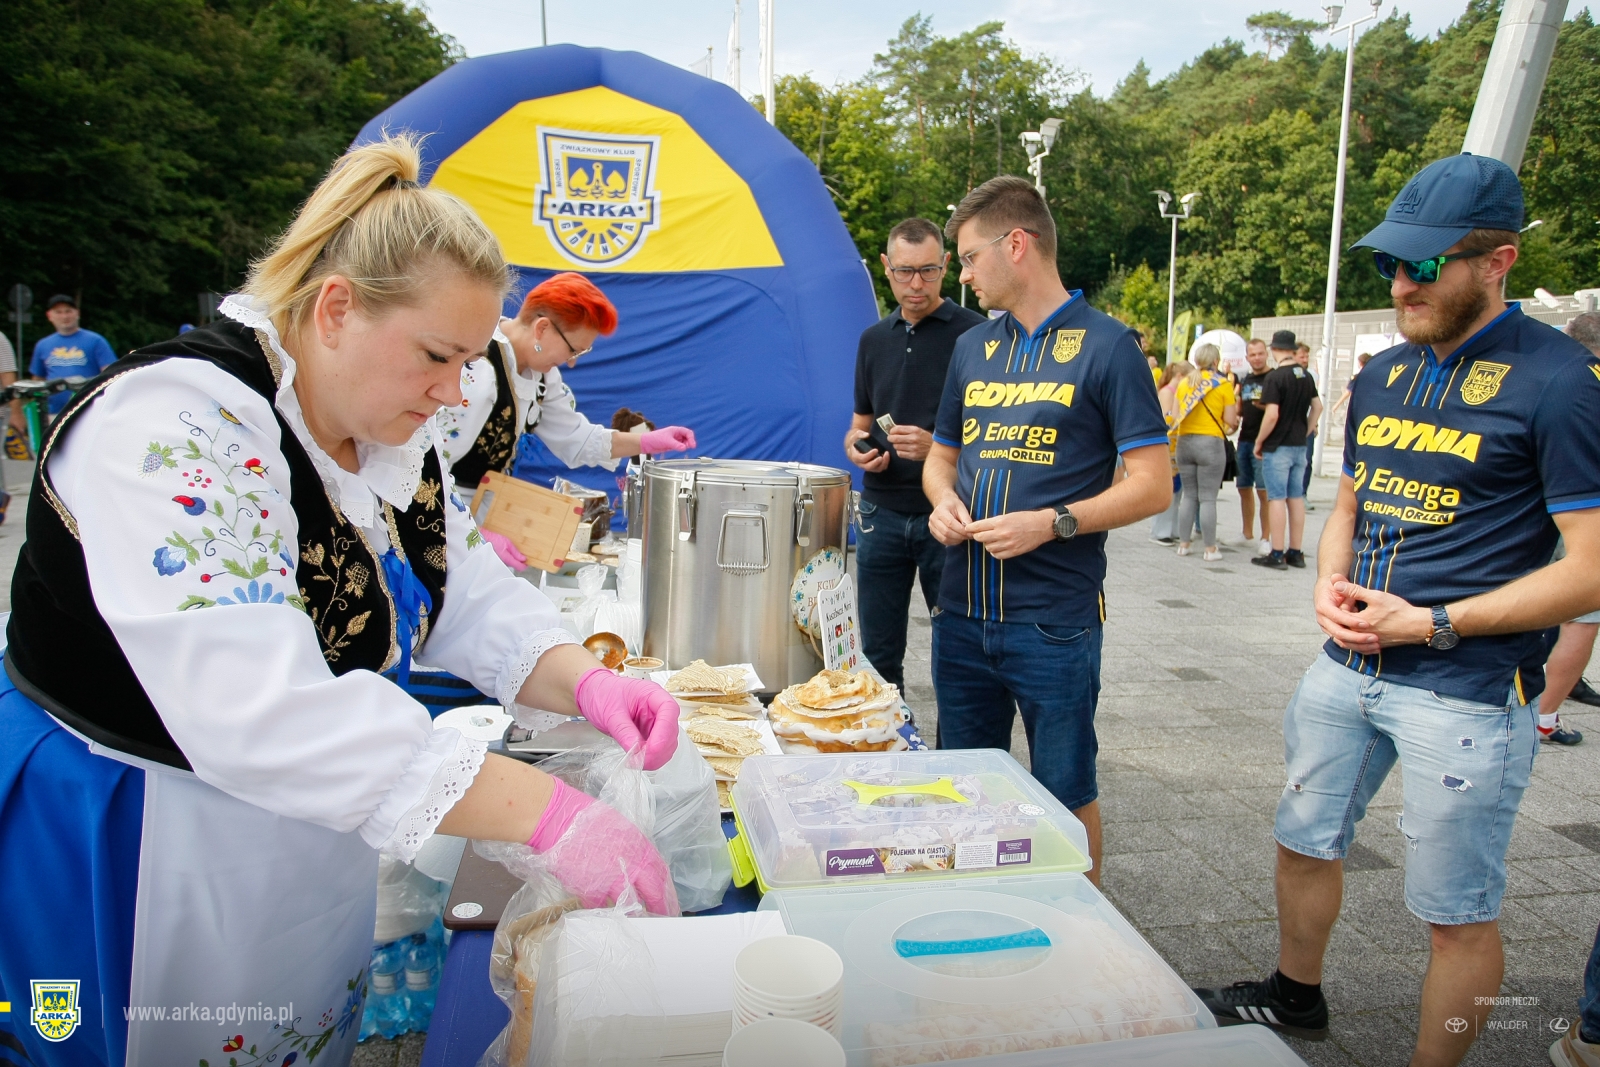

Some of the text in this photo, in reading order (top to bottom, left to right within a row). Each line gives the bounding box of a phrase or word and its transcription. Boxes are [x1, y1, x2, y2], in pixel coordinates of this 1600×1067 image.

[632, 158, 642, 197] SPORTOWY
[557, 202, 637, 217] ARKA
[964, 381, 1075, 408] GDYNIA
[984, 422, 1058, 448] Energa
[1356, 414, 1482, 464] GDYNIA
[979, 449, 1051, 462] GRUPA ORLEN
[1368, 468, 1460, 510] Energa
[1363, 500, 1449, 523] GRUPA ORLEN
[918, 847, 926, 855] NA
[927, 846, 946, 855] CIASTO
